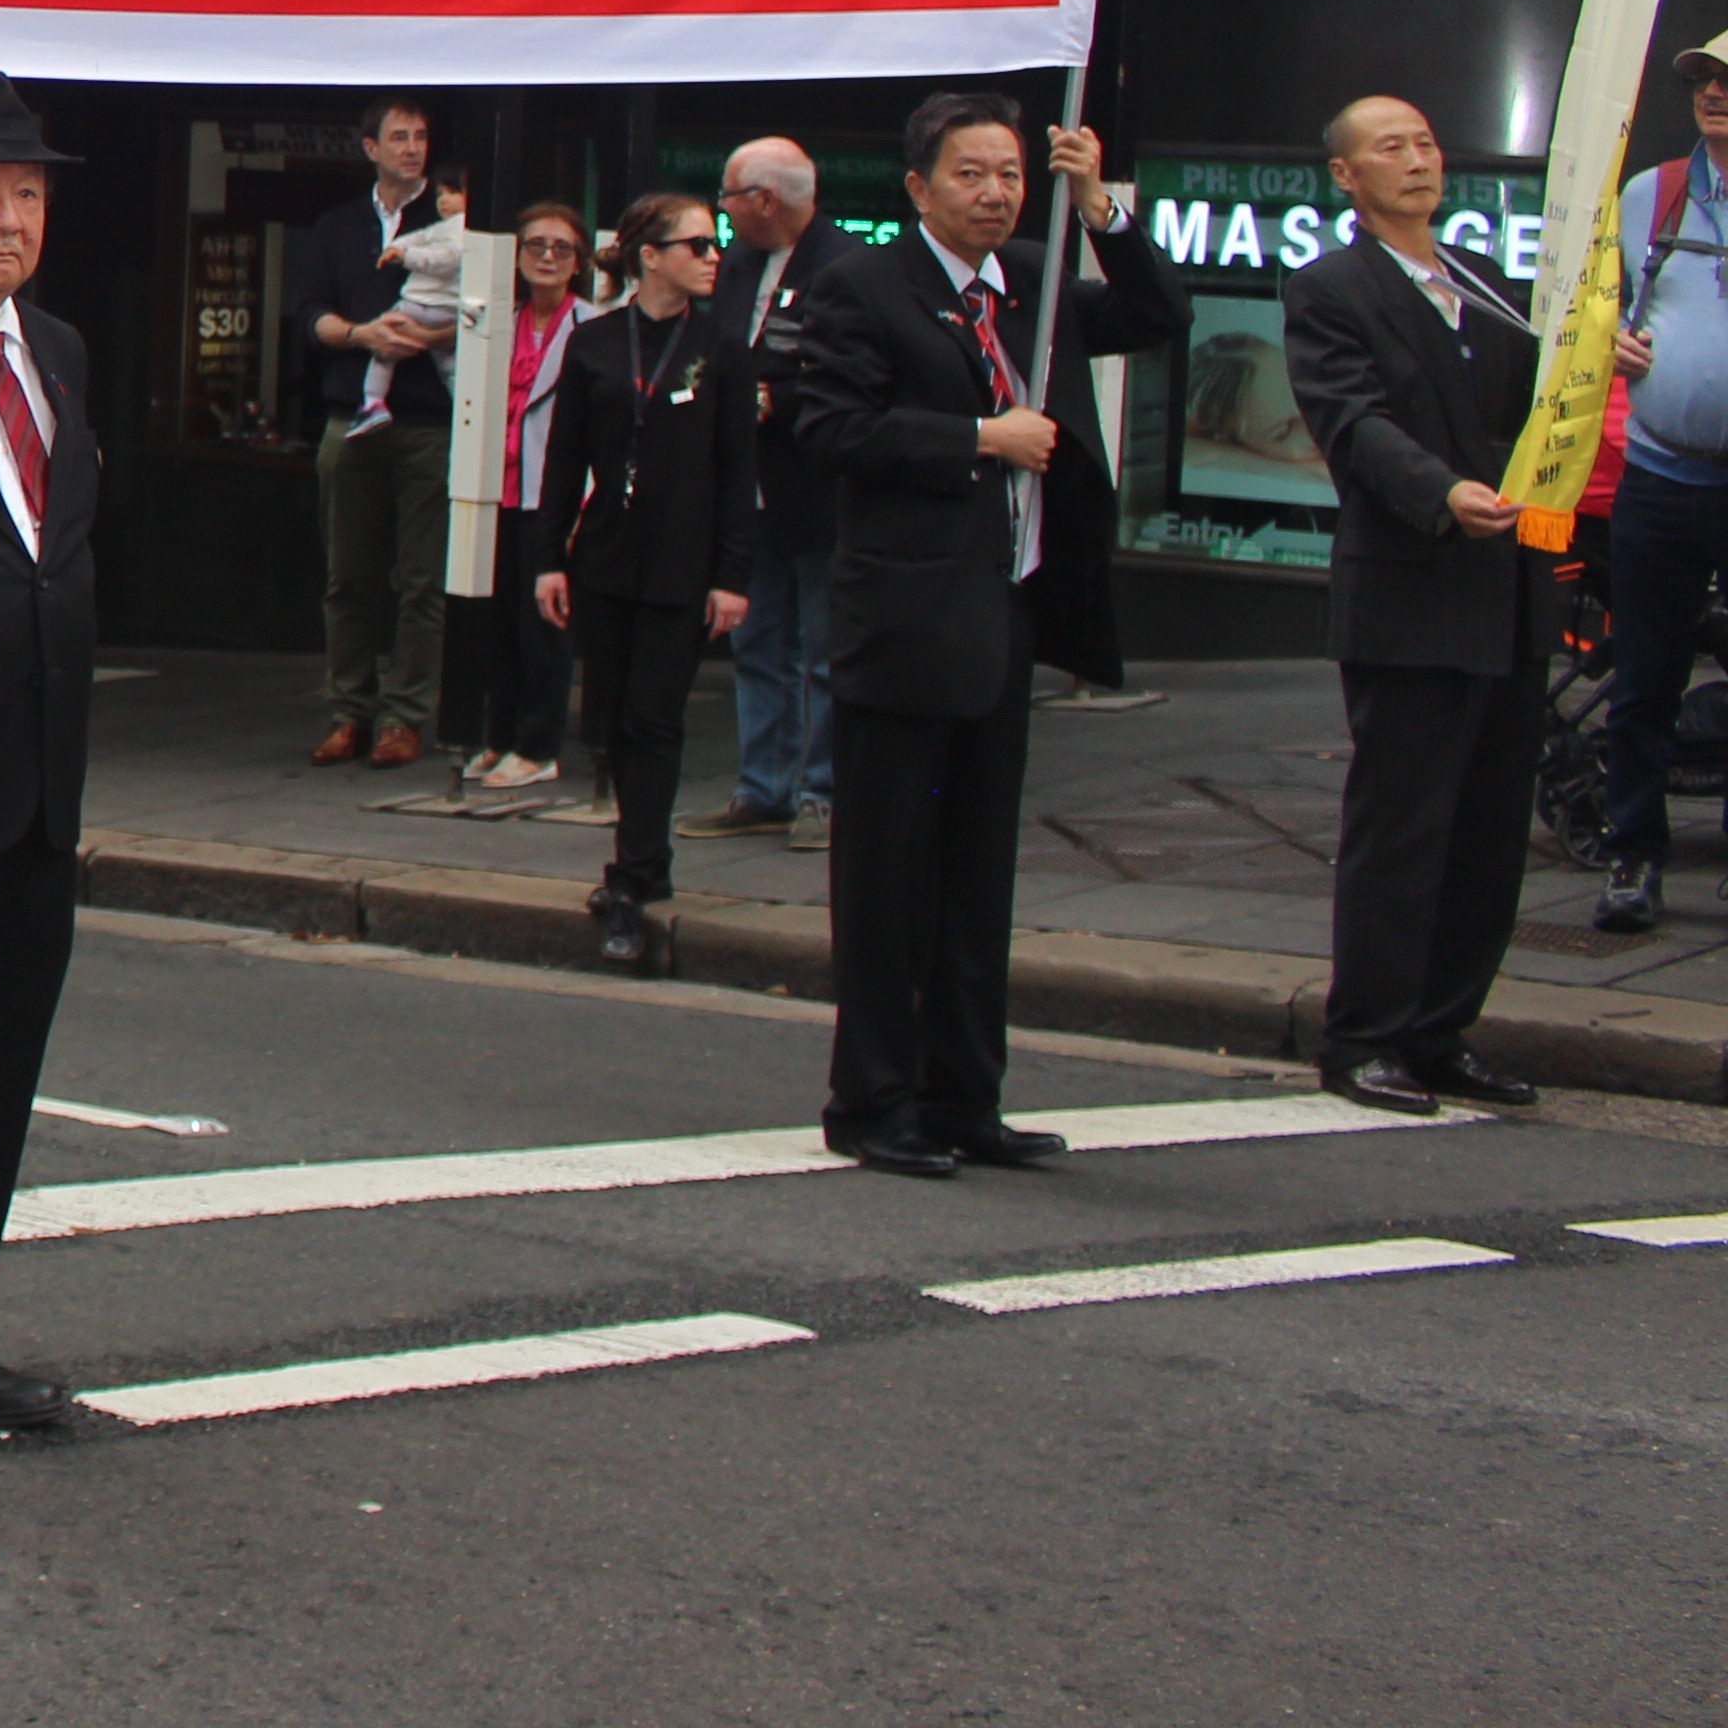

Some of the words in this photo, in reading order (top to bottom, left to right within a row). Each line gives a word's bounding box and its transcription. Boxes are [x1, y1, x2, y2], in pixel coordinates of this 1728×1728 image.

[1182, 165, 1239, 195] PH:
[1248, 166, 1319, 201] (02)
[198, 308, 250, 339] $30
